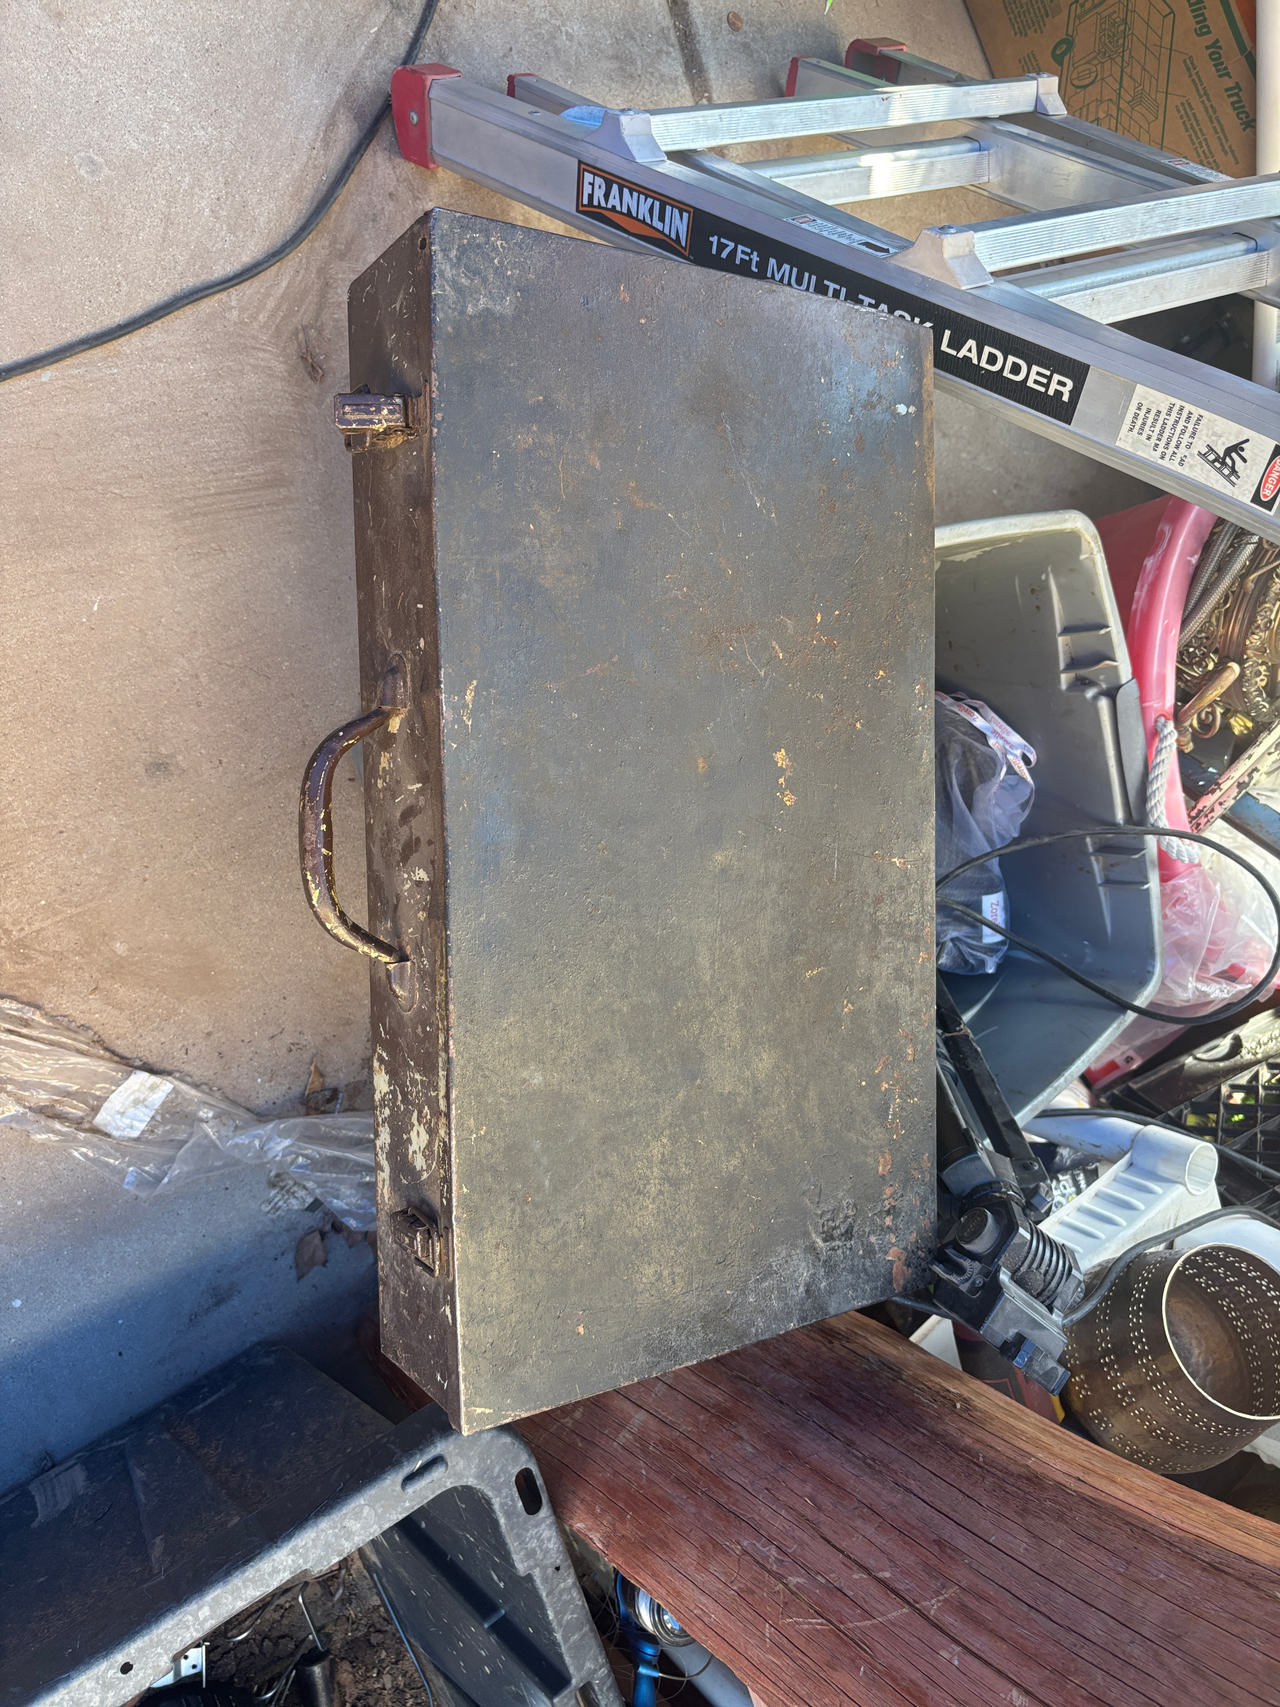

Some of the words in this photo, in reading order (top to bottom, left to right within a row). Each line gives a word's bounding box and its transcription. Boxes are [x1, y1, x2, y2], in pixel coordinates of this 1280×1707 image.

[1205, 38, 1232, 79] Your
[1224, 81, 1256, 132] Truck
[582, 171, 689, 248] FRANKLIN
[708, 235, 760, 273] 17Ft
[940, 330, 1075, 403] LADDER
[1135, 401, 1144, 412] OR
[1165, 402, 1176, 417] THIS
[1184, 410, 1194, 425] AND
[1136, 407, 1152, 436] INJURIES
[1149, 409, 1162, 434] RESULT
[1156, 417, 1170, 443] LADDER
[1162, 405, 1185, 451] INSTRUCTIONS
[1188, 413, 1204, 440] FAILURE
[1145, 433, 1153, 442] IN
[1152, 442, 1160, 452] MA
[1174, 424, 1189, 451] FOLLOW
[1184, 441, 1193, 450] TO
[1159, 450, 1167, 460] ON
[1169, 450, 1178, 462] ALL
